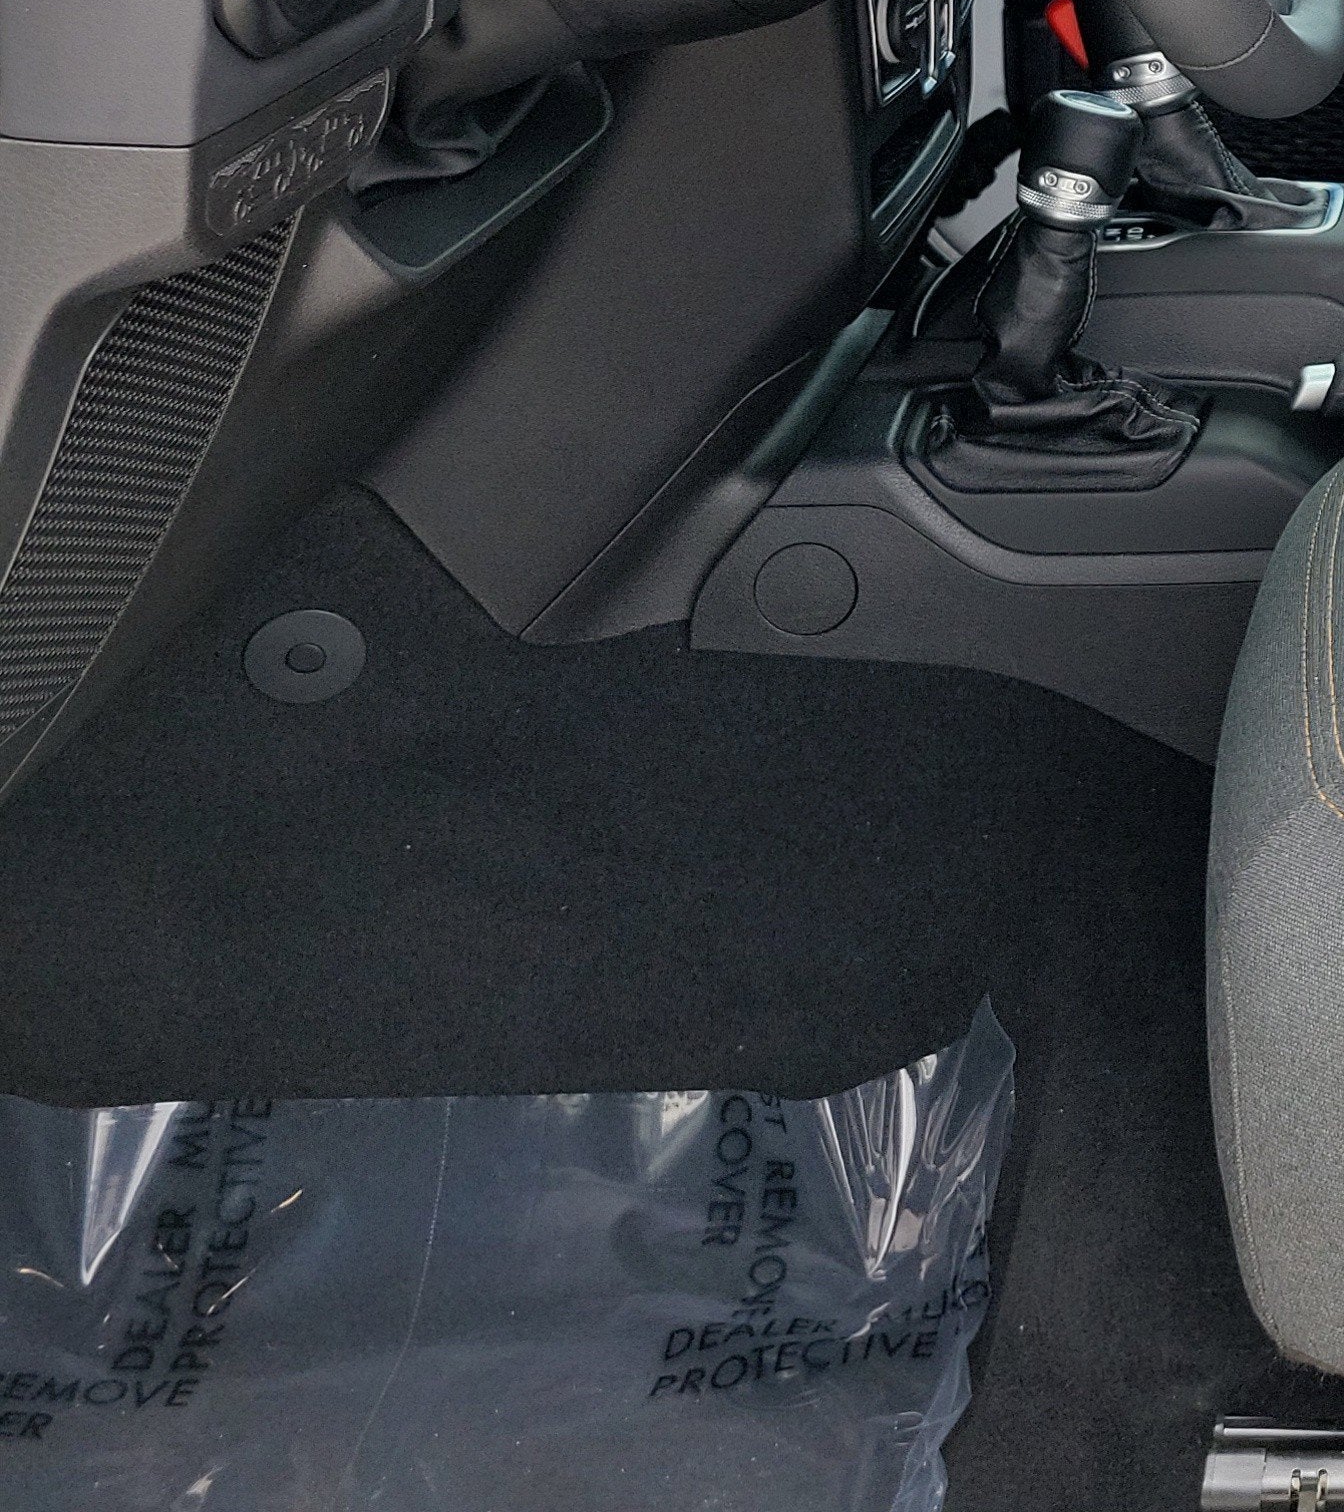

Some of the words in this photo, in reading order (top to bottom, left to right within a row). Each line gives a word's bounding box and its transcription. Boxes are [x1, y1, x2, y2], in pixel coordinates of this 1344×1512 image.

[170, 1100, 272, 1372] PROTECTIVE
[702, 1094, 751, 1246] COVER
[731, 1159, 796, 1318] REMOVE
[111, 1206, 195, 1371] DEALER
[650, 1331, 939, 1397] PROTECTIVE
[664, 1317, 838, 1363] DEALER
[0, 1372, 200, 1408] EMOVE
